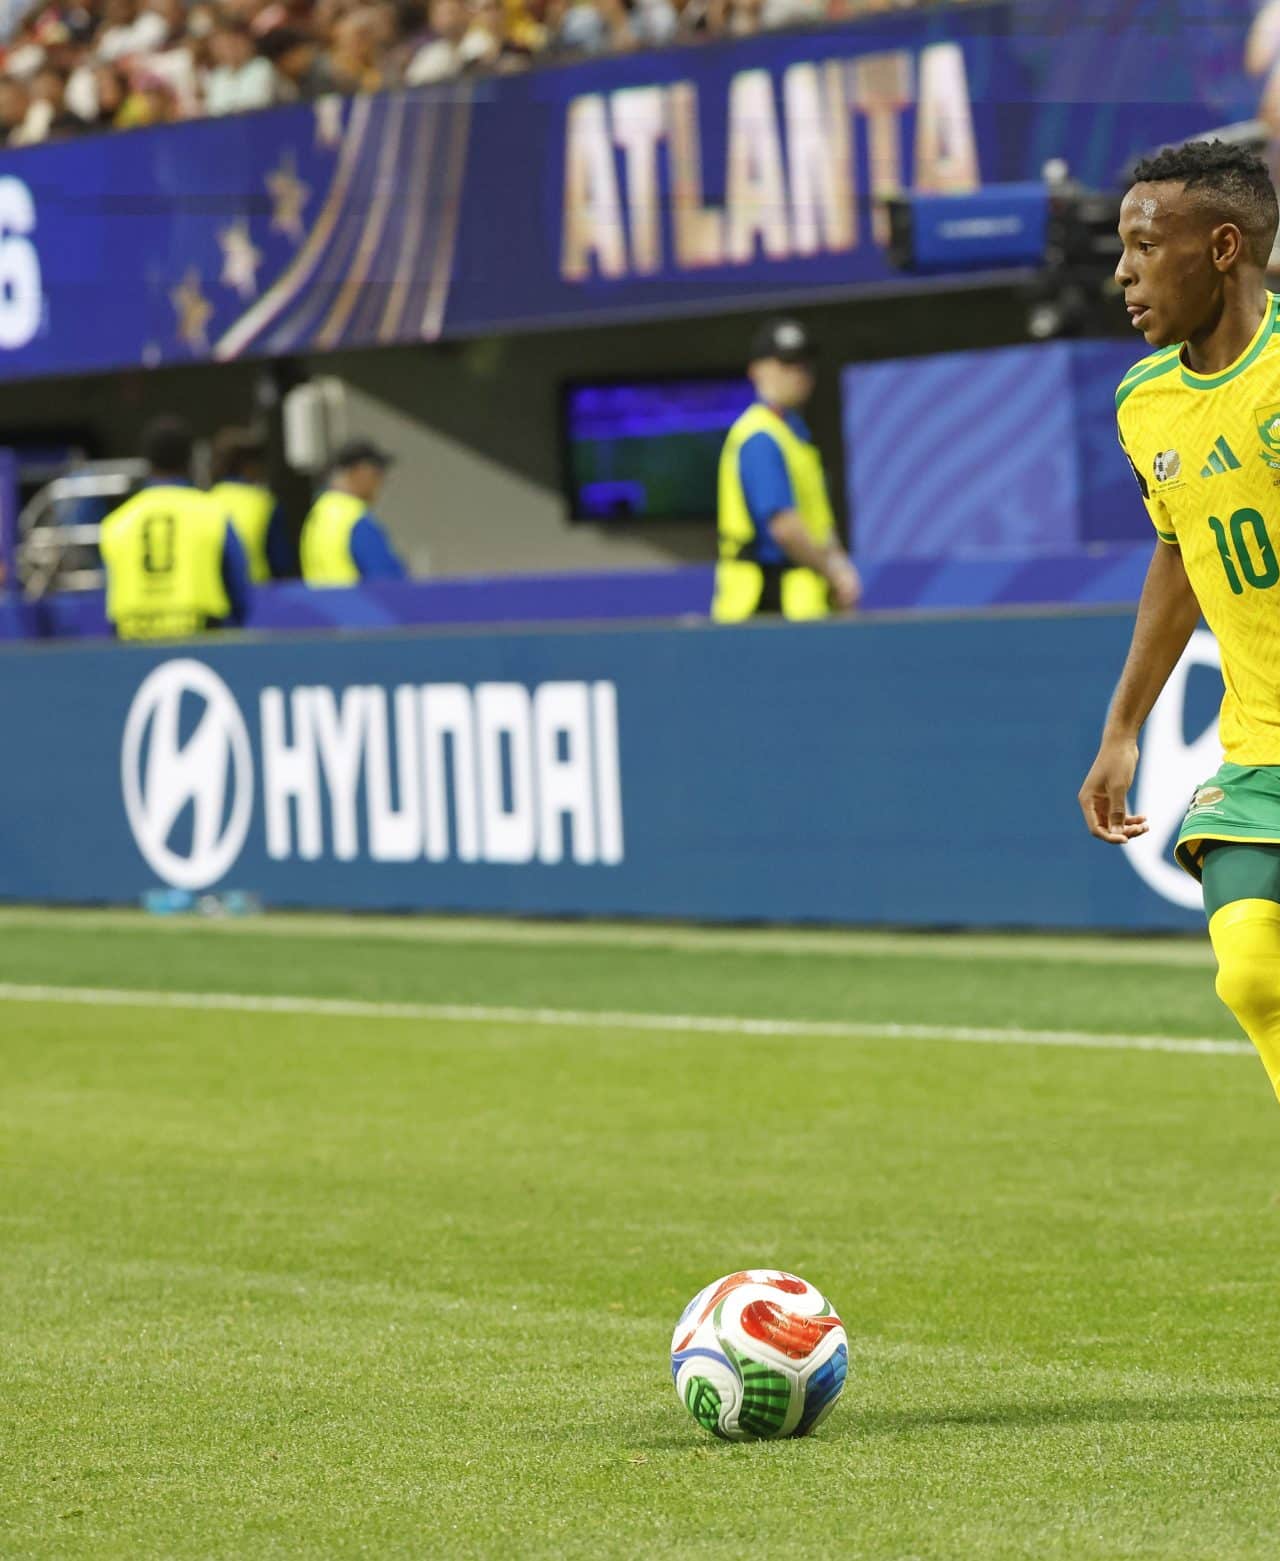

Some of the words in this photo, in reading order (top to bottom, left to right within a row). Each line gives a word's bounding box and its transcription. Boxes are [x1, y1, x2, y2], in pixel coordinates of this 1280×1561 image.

[561, 41, 981, 282] ATLANTA
[1208, 508, 1280, 595] 10
[259, 680, 624, 865] HYUNDAI
